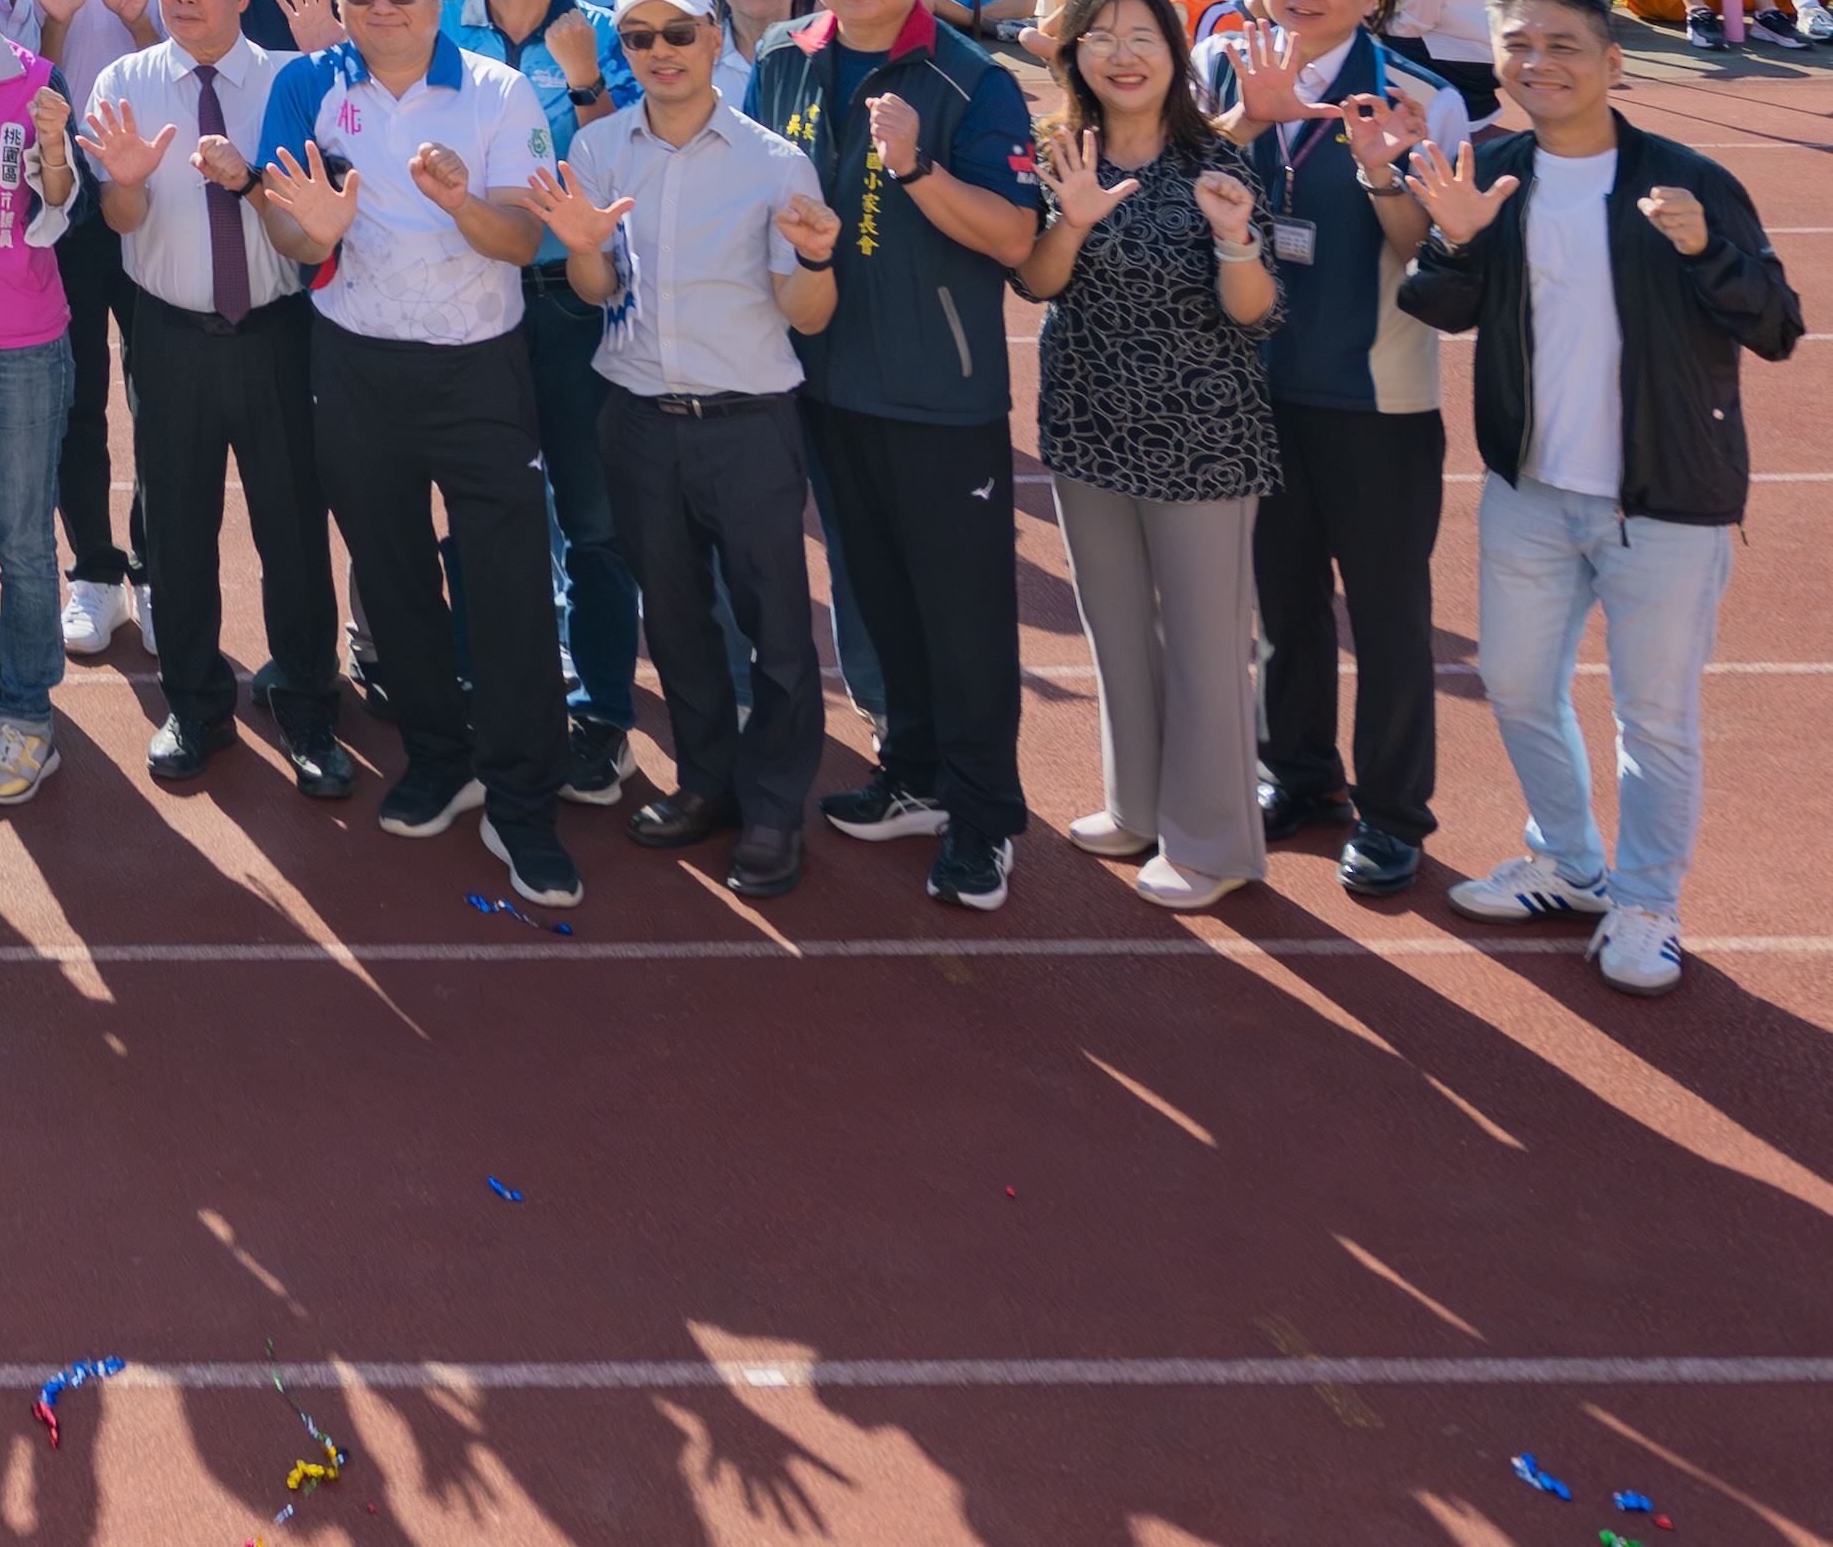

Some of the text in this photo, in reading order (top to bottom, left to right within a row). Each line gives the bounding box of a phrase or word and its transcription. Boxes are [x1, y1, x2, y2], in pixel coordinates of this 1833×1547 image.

[2, 124, 24, 185] 桃園區
[855, 145, 884, 256] 國小家長會
